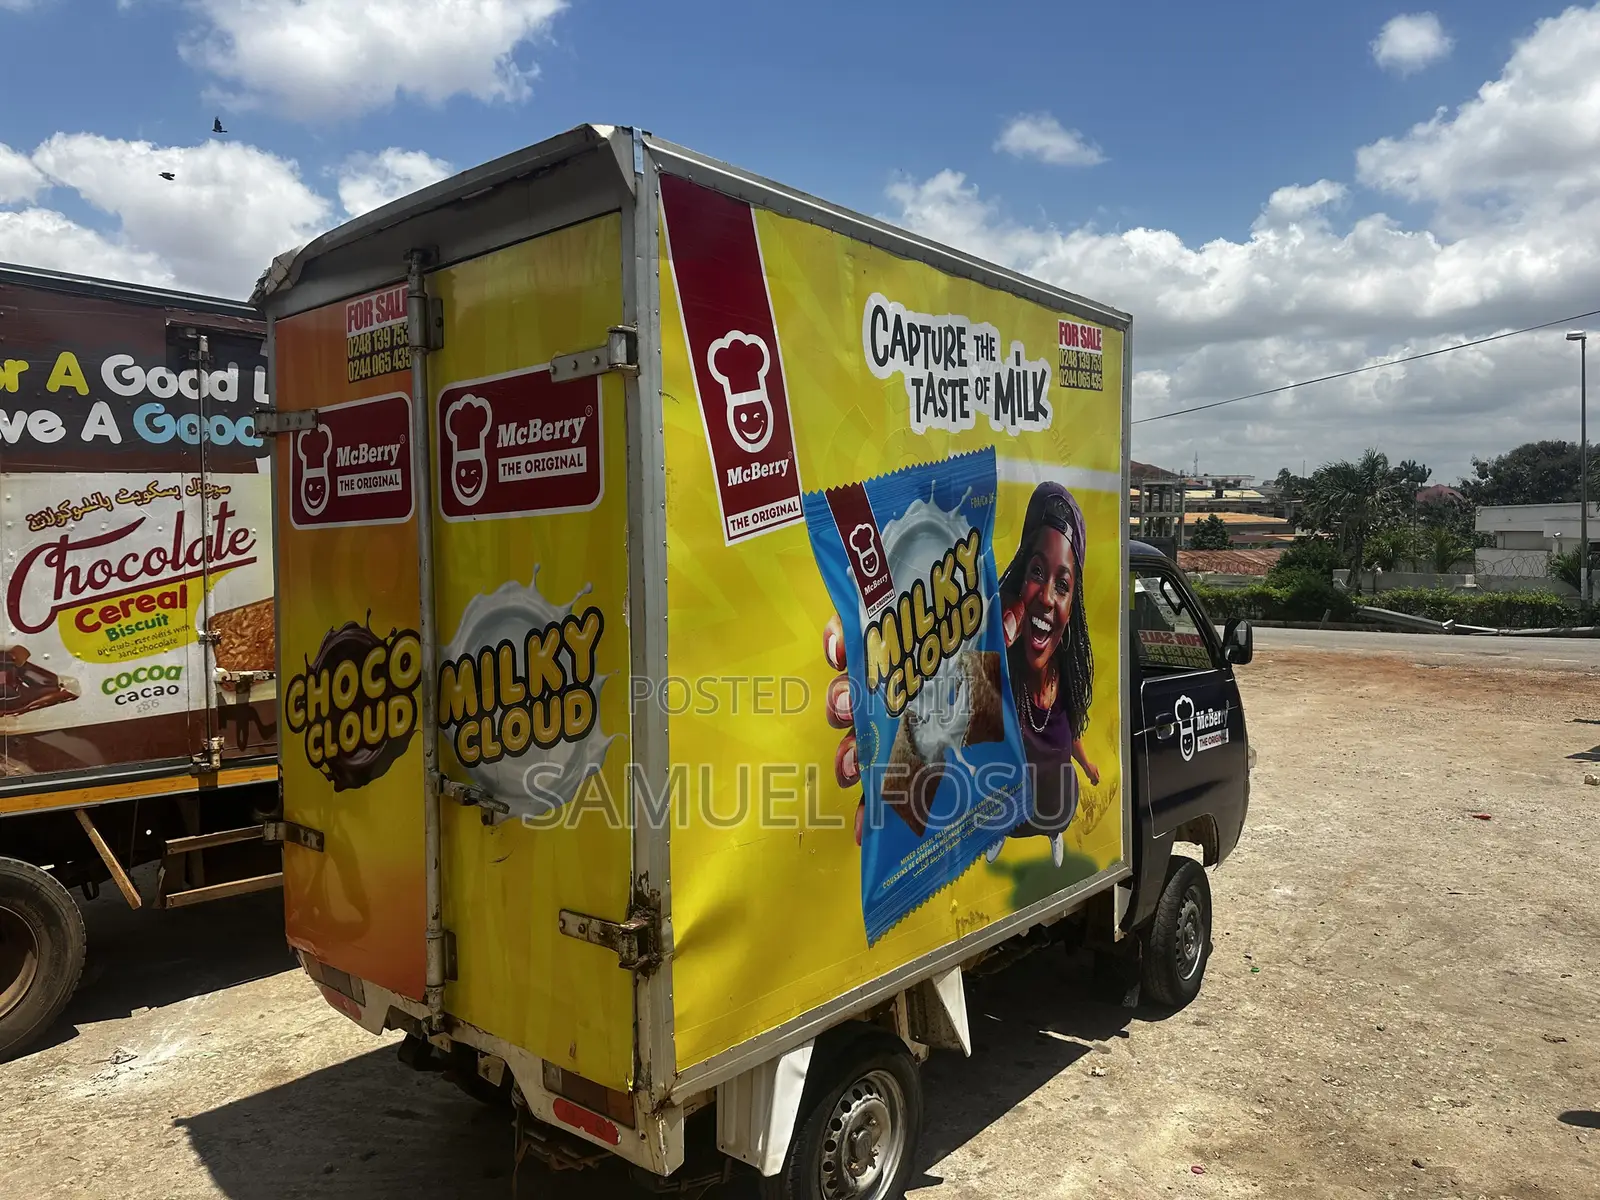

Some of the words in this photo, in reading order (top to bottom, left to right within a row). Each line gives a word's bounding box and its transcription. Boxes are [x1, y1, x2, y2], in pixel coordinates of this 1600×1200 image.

[347, 298, 374, 333] FOR
[347, 332, 372, 359] 0248
[372, 326, 391, 351] 139
[870, 304, 968, 371] CAPTURE
[973, 332, 996, 362] THE
[1058, 321, 1079, 347] FOR
[1080, 325, 1102, 351] SALE
[348, 356, 372, 382] 0244
[372, 352, 392, 376] 065
[392, 347, 412, 370] 435
[1059, 348, 1078, 368] 0248
[1078, 352, 1090, 370] 139
[1090, 354, 1102, 372] 753
[46, 351, 90, 396] A
[100, 354, 239, 403] Good
[1060, 368, 1077, 387] 0244
[1077, 370, 1091, 389] 065
[1090, 373, 1103, 391] 435
[911, 371, 970, 423] TASTE
[974, 376, 991, 405] OF
[80, 401, 123, 444] A
[495, 415, 587, 449] McBerry
[335, 443, 401, 468] McBerry
[501, 461, 523, 477] THE
[523, 453, 584, 475] ORIGINAL
[339, 478, 355, 491] THE
[356, 473, 400, 489] ORIGINAL
[726, 458, 790, 487] McBerry
[729, 515, 750, 532] THE
[751, 500, 799, 525] ORIGINAL
[7, 501, 257, 634] Chocolate
[863, 573, 888, 596] McBerry
[75, 584, 188, 634] Cereal
[864, 526, 981, 694] MILKY
[105, 613, 169, 642] Biscuit
[139, 638, 178, 653] chocolate
[886, 589, 983, 717] CLOUD
[101, 664, 184, 695] cocoa
[286, 628, 421, 733] CHOCO
[438, 606, 605, 730] MILKY
[114, 684, 179, 706] cacao
[304, 694, 418, 769] CLOUD
[453, 683, 598, 768] CLOUD
[1196, 708, 1229, 731] McBerry
